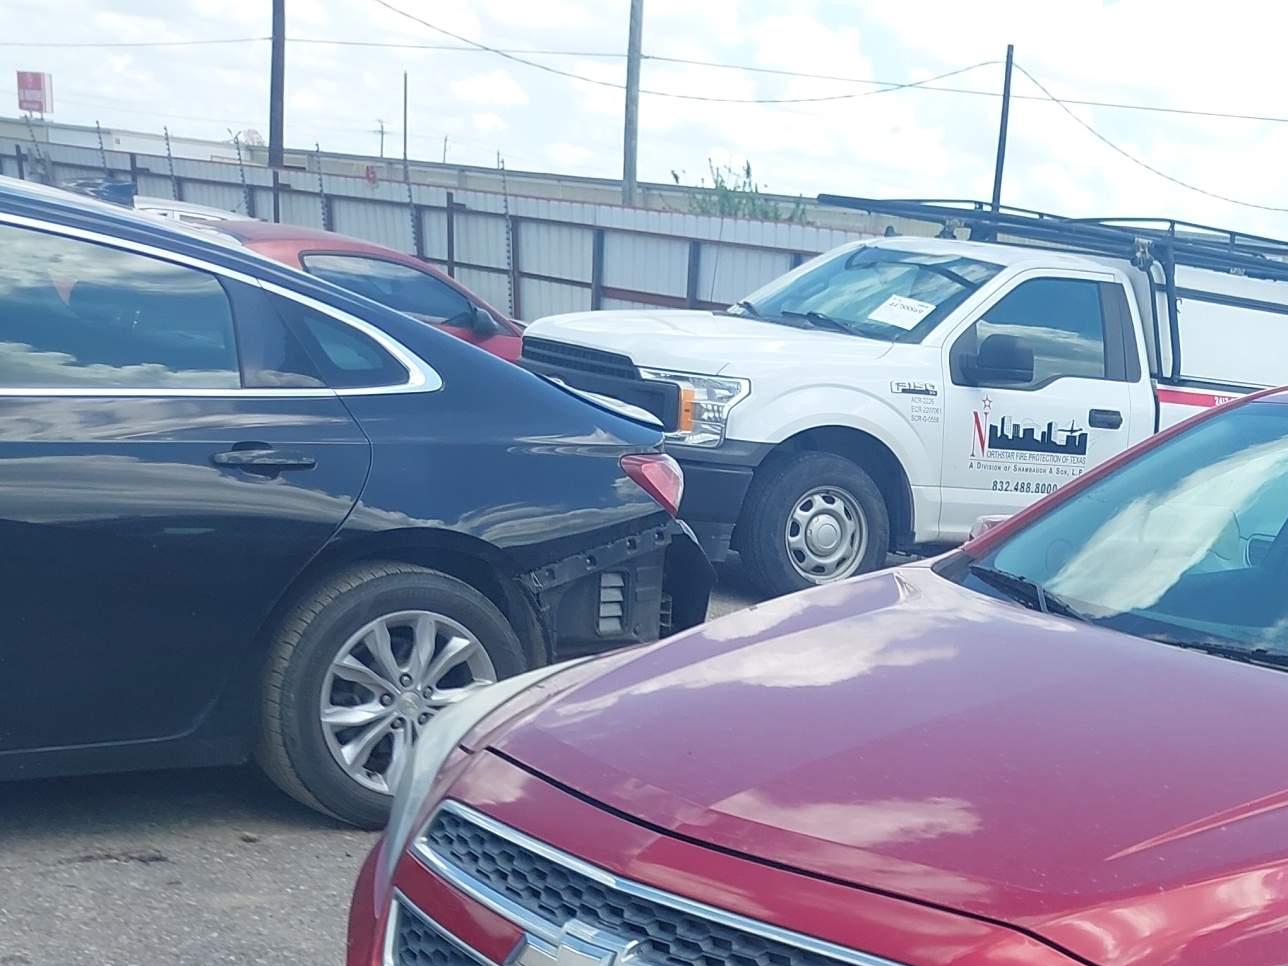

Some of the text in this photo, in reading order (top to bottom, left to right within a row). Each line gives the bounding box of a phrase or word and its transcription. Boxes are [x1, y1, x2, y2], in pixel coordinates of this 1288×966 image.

[1015, 453, 1027, 461] FIRE
[1028, 453, 1061, 463] PROTECTION
[1071, 456, 1087, 465] TEXAS
[992, 480, 1058, 494] 832.488.8000
